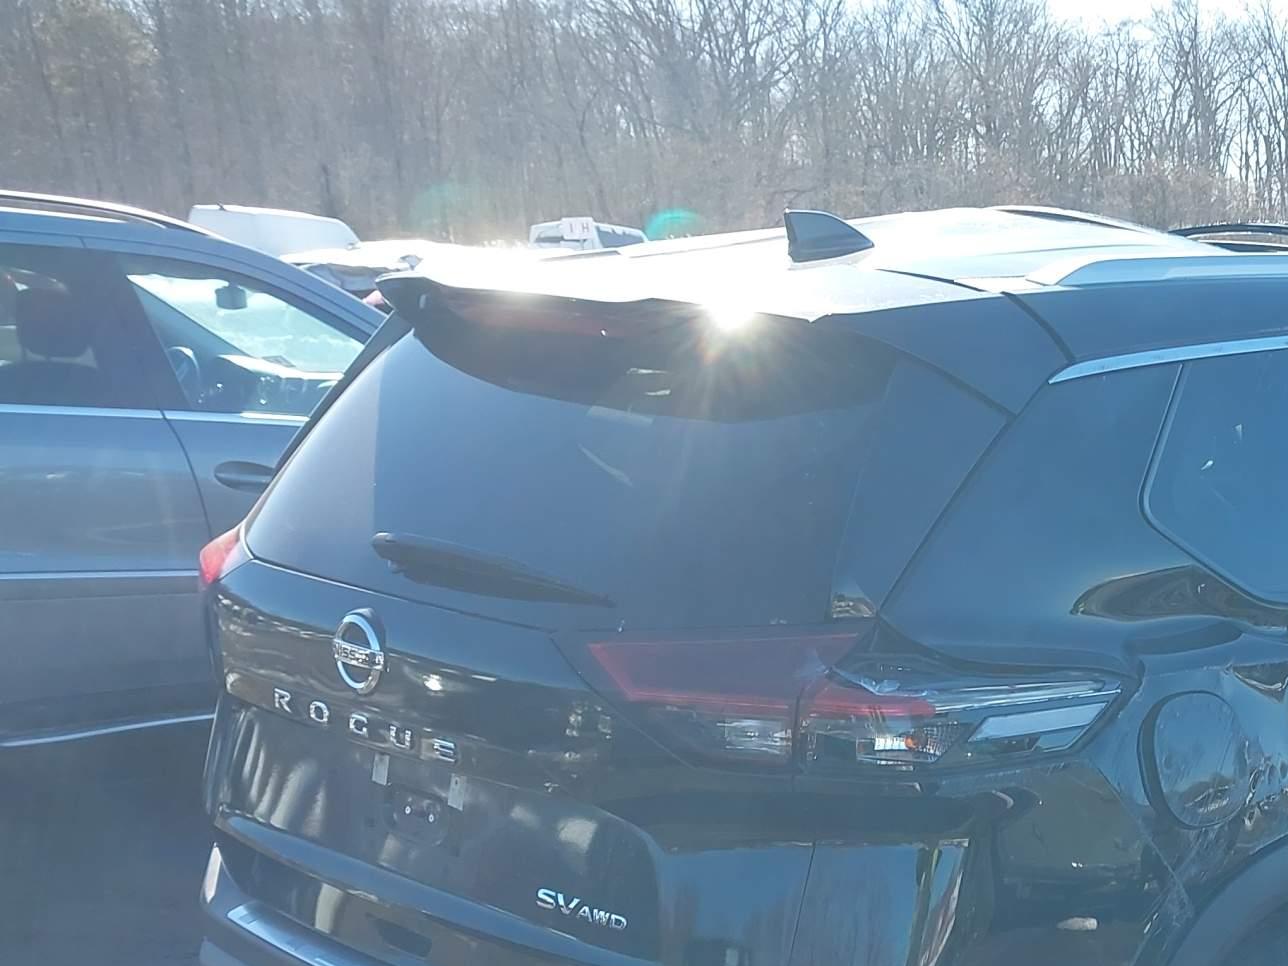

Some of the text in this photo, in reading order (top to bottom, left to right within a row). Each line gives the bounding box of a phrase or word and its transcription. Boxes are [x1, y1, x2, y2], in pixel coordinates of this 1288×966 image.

[582, 222, 590, 233] H
[273, 687, 457, 763] ROGUE
[536, 888, 628, 931] SV AWD
